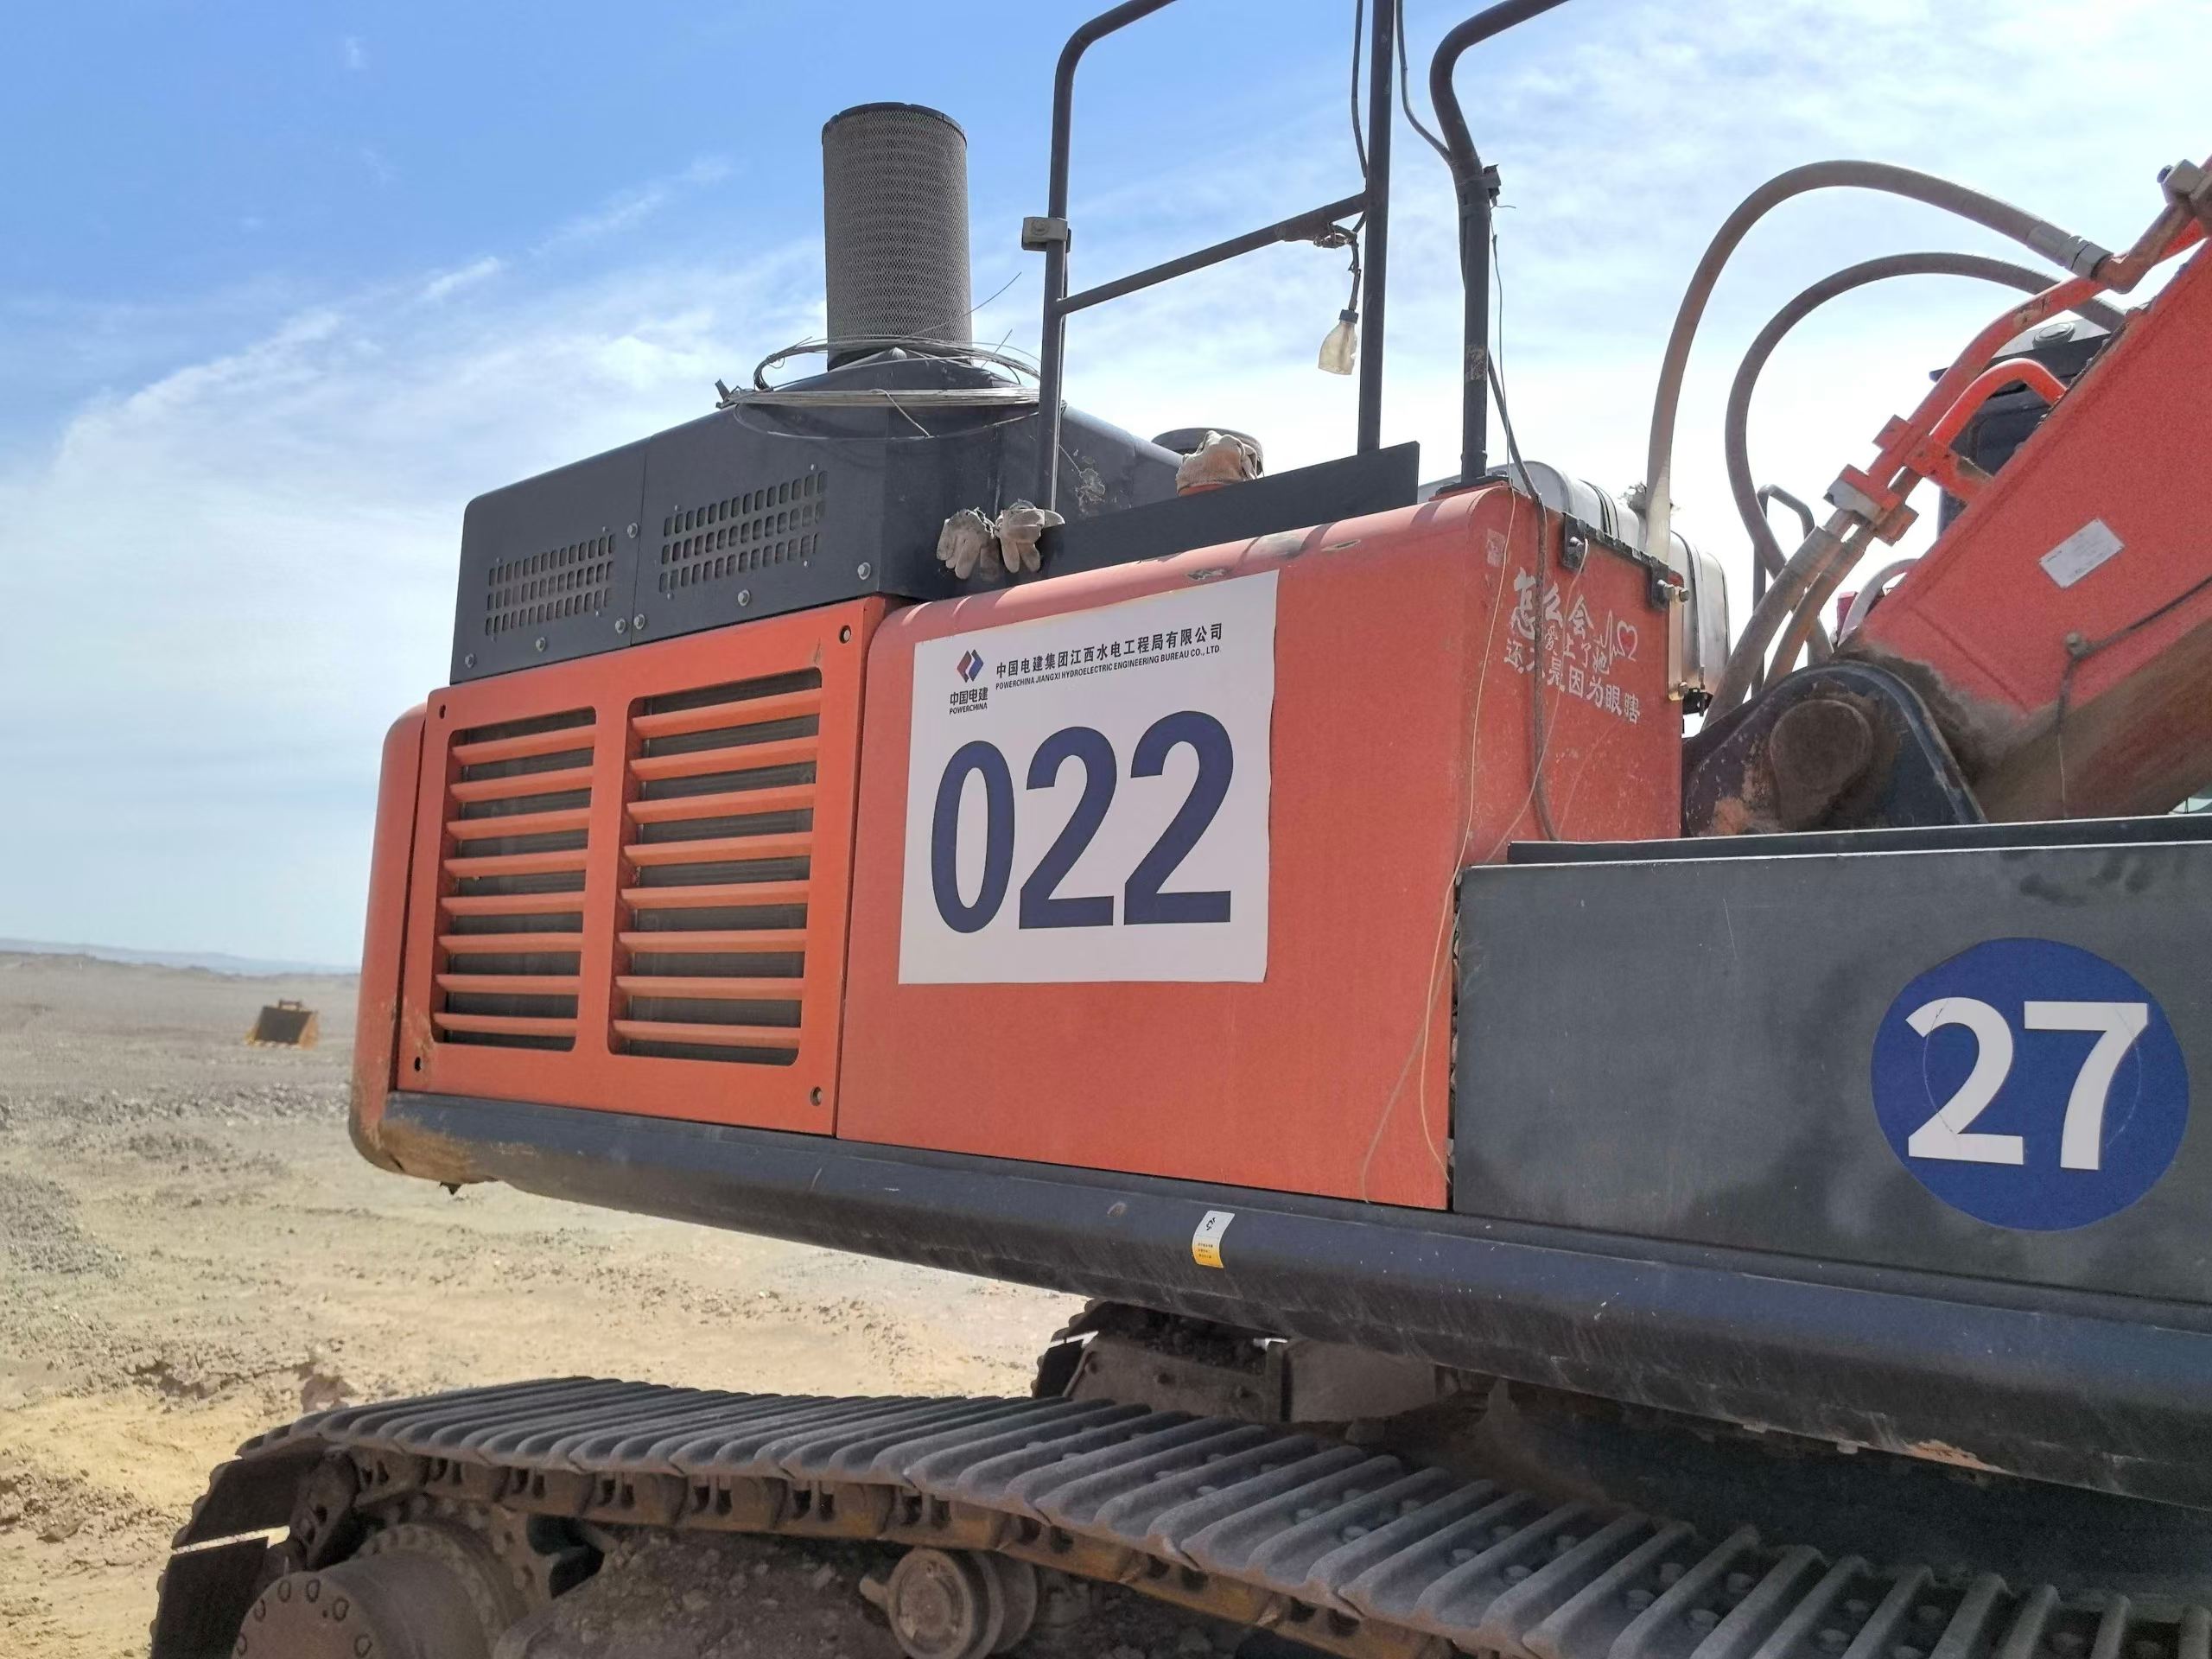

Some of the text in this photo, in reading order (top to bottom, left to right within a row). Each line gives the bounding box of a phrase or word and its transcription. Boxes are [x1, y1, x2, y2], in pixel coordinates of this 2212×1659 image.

[995, 622, 1223, 679] 中国电建集团江西水电工程局有限公司
[995, 678, 1035, 690] POWERCHINA
[1036, 671, 1060, 684] JIANGXI
[1061, 664, 1113, 679] HYDROELECTRIC
[1114, 655, 1160, 671] ENGINEERING
[1160, 649, 1190, 663] BUREAU
[949, 702, 988, 715] POWERCHINA
[950, 686, 988, 706] 中国电建
[931, 710, 1234, 934] 022
[1905, 996, 2148, 1171] 27
